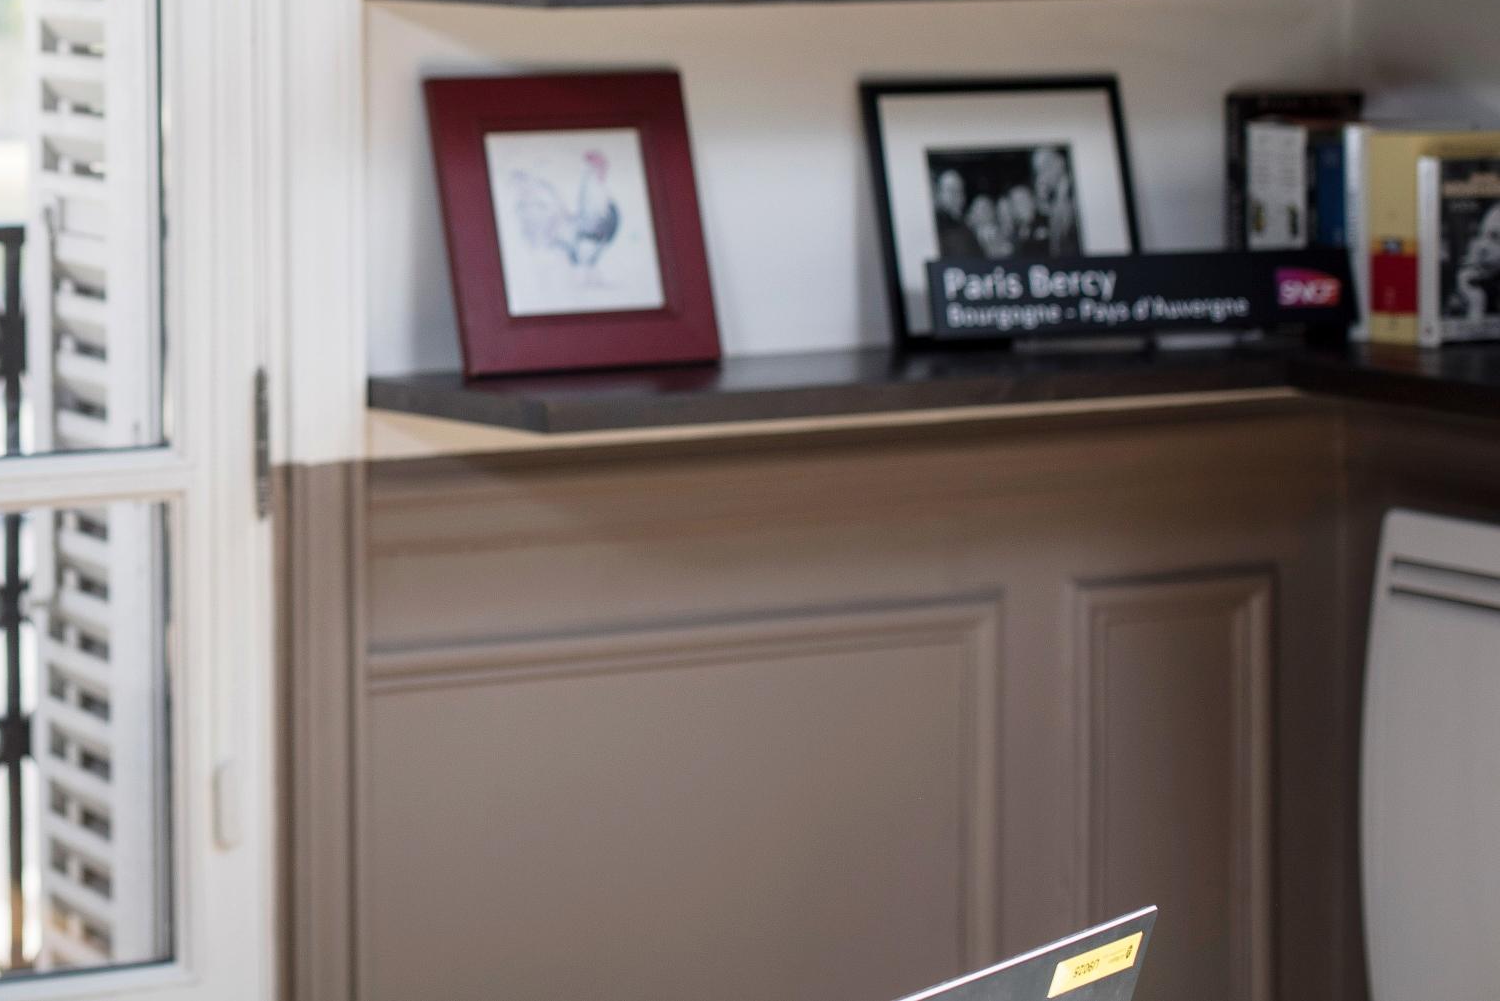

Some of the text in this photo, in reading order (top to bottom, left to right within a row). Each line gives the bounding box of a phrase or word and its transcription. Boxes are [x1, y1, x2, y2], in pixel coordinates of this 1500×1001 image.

[943, 264, 1117, 301] Paris Bercy
[1277, 278, 1341, 306] SNCF
[947, 302, 1063, 331] Bourgogne
[1078, 298, 1130, 326] Pays
[1132, 296, 1248, 323] d'Auvergne
